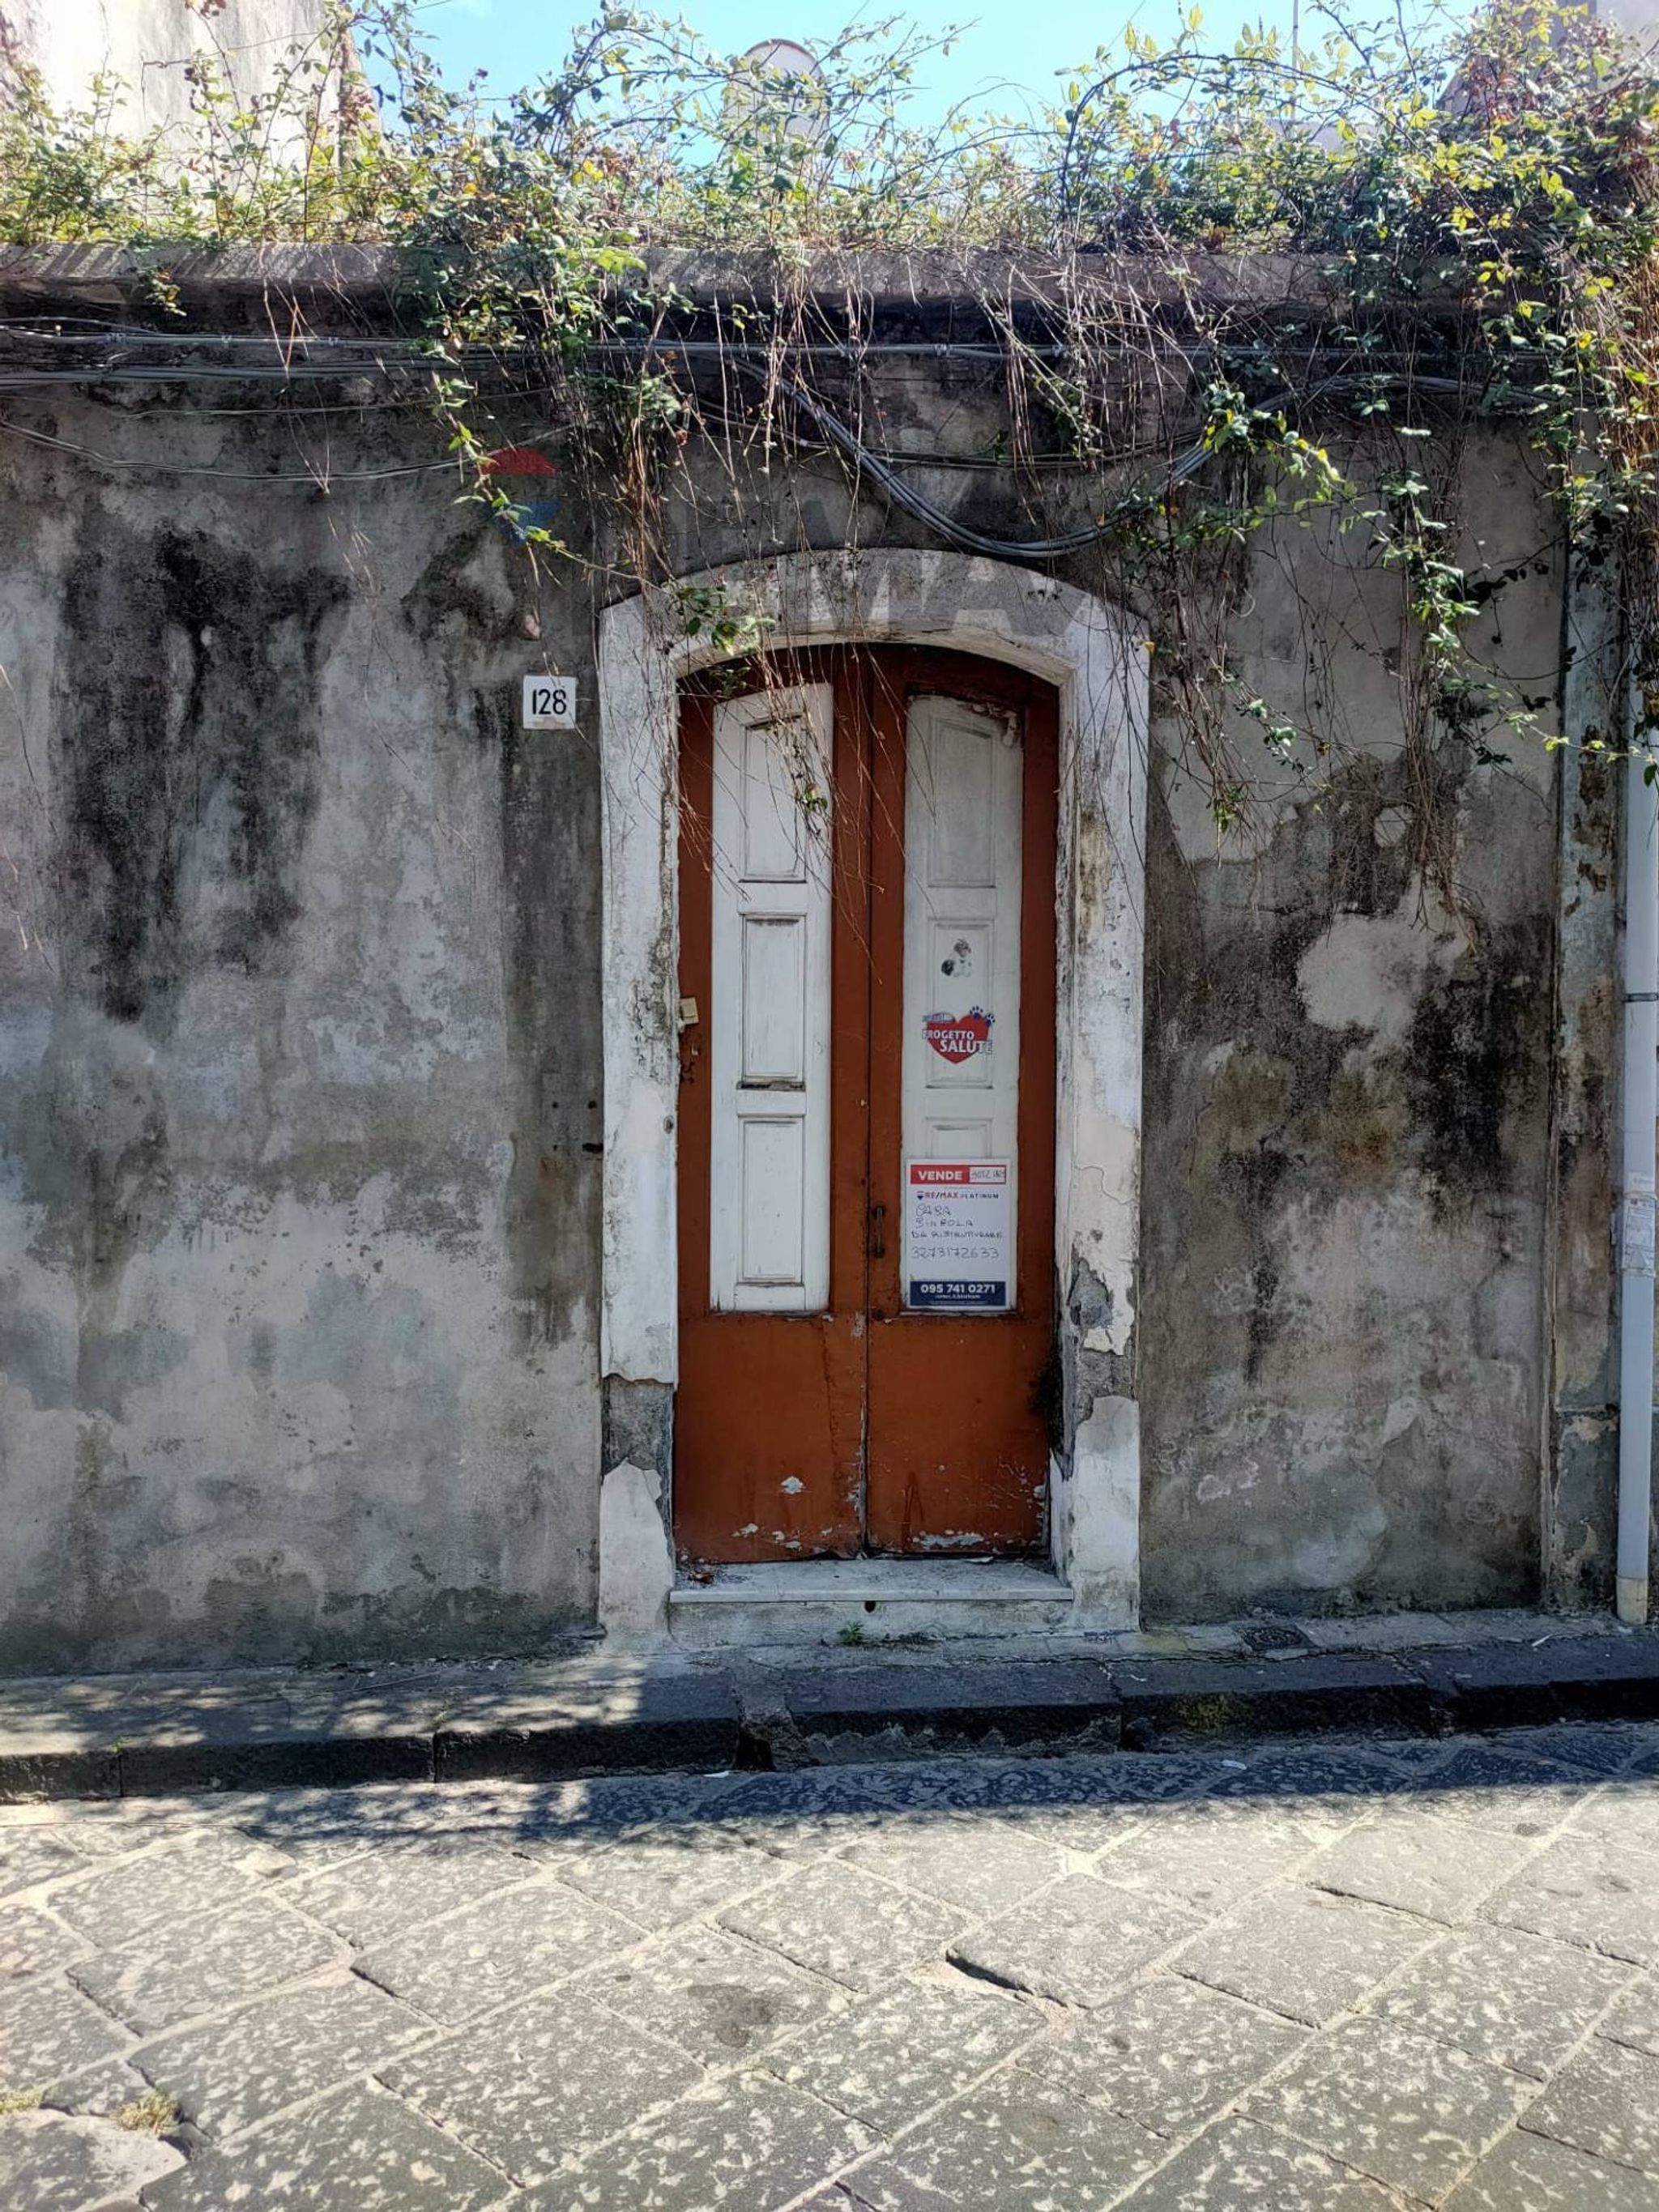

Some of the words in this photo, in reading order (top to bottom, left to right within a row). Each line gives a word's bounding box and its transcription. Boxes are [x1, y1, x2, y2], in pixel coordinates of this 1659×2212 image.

[532, 688, 567, 715] 128
[940, 1040, 993, 1055] SALUTE
[918, 1170, 963, 1181] VENDE
[925, 1191, 959, 1200] RE/MAX
[920, 1284, 944, 1294] 095
[946, 1284, 965, 1294] 741
[968, 1284, 996, 1294] 0271
